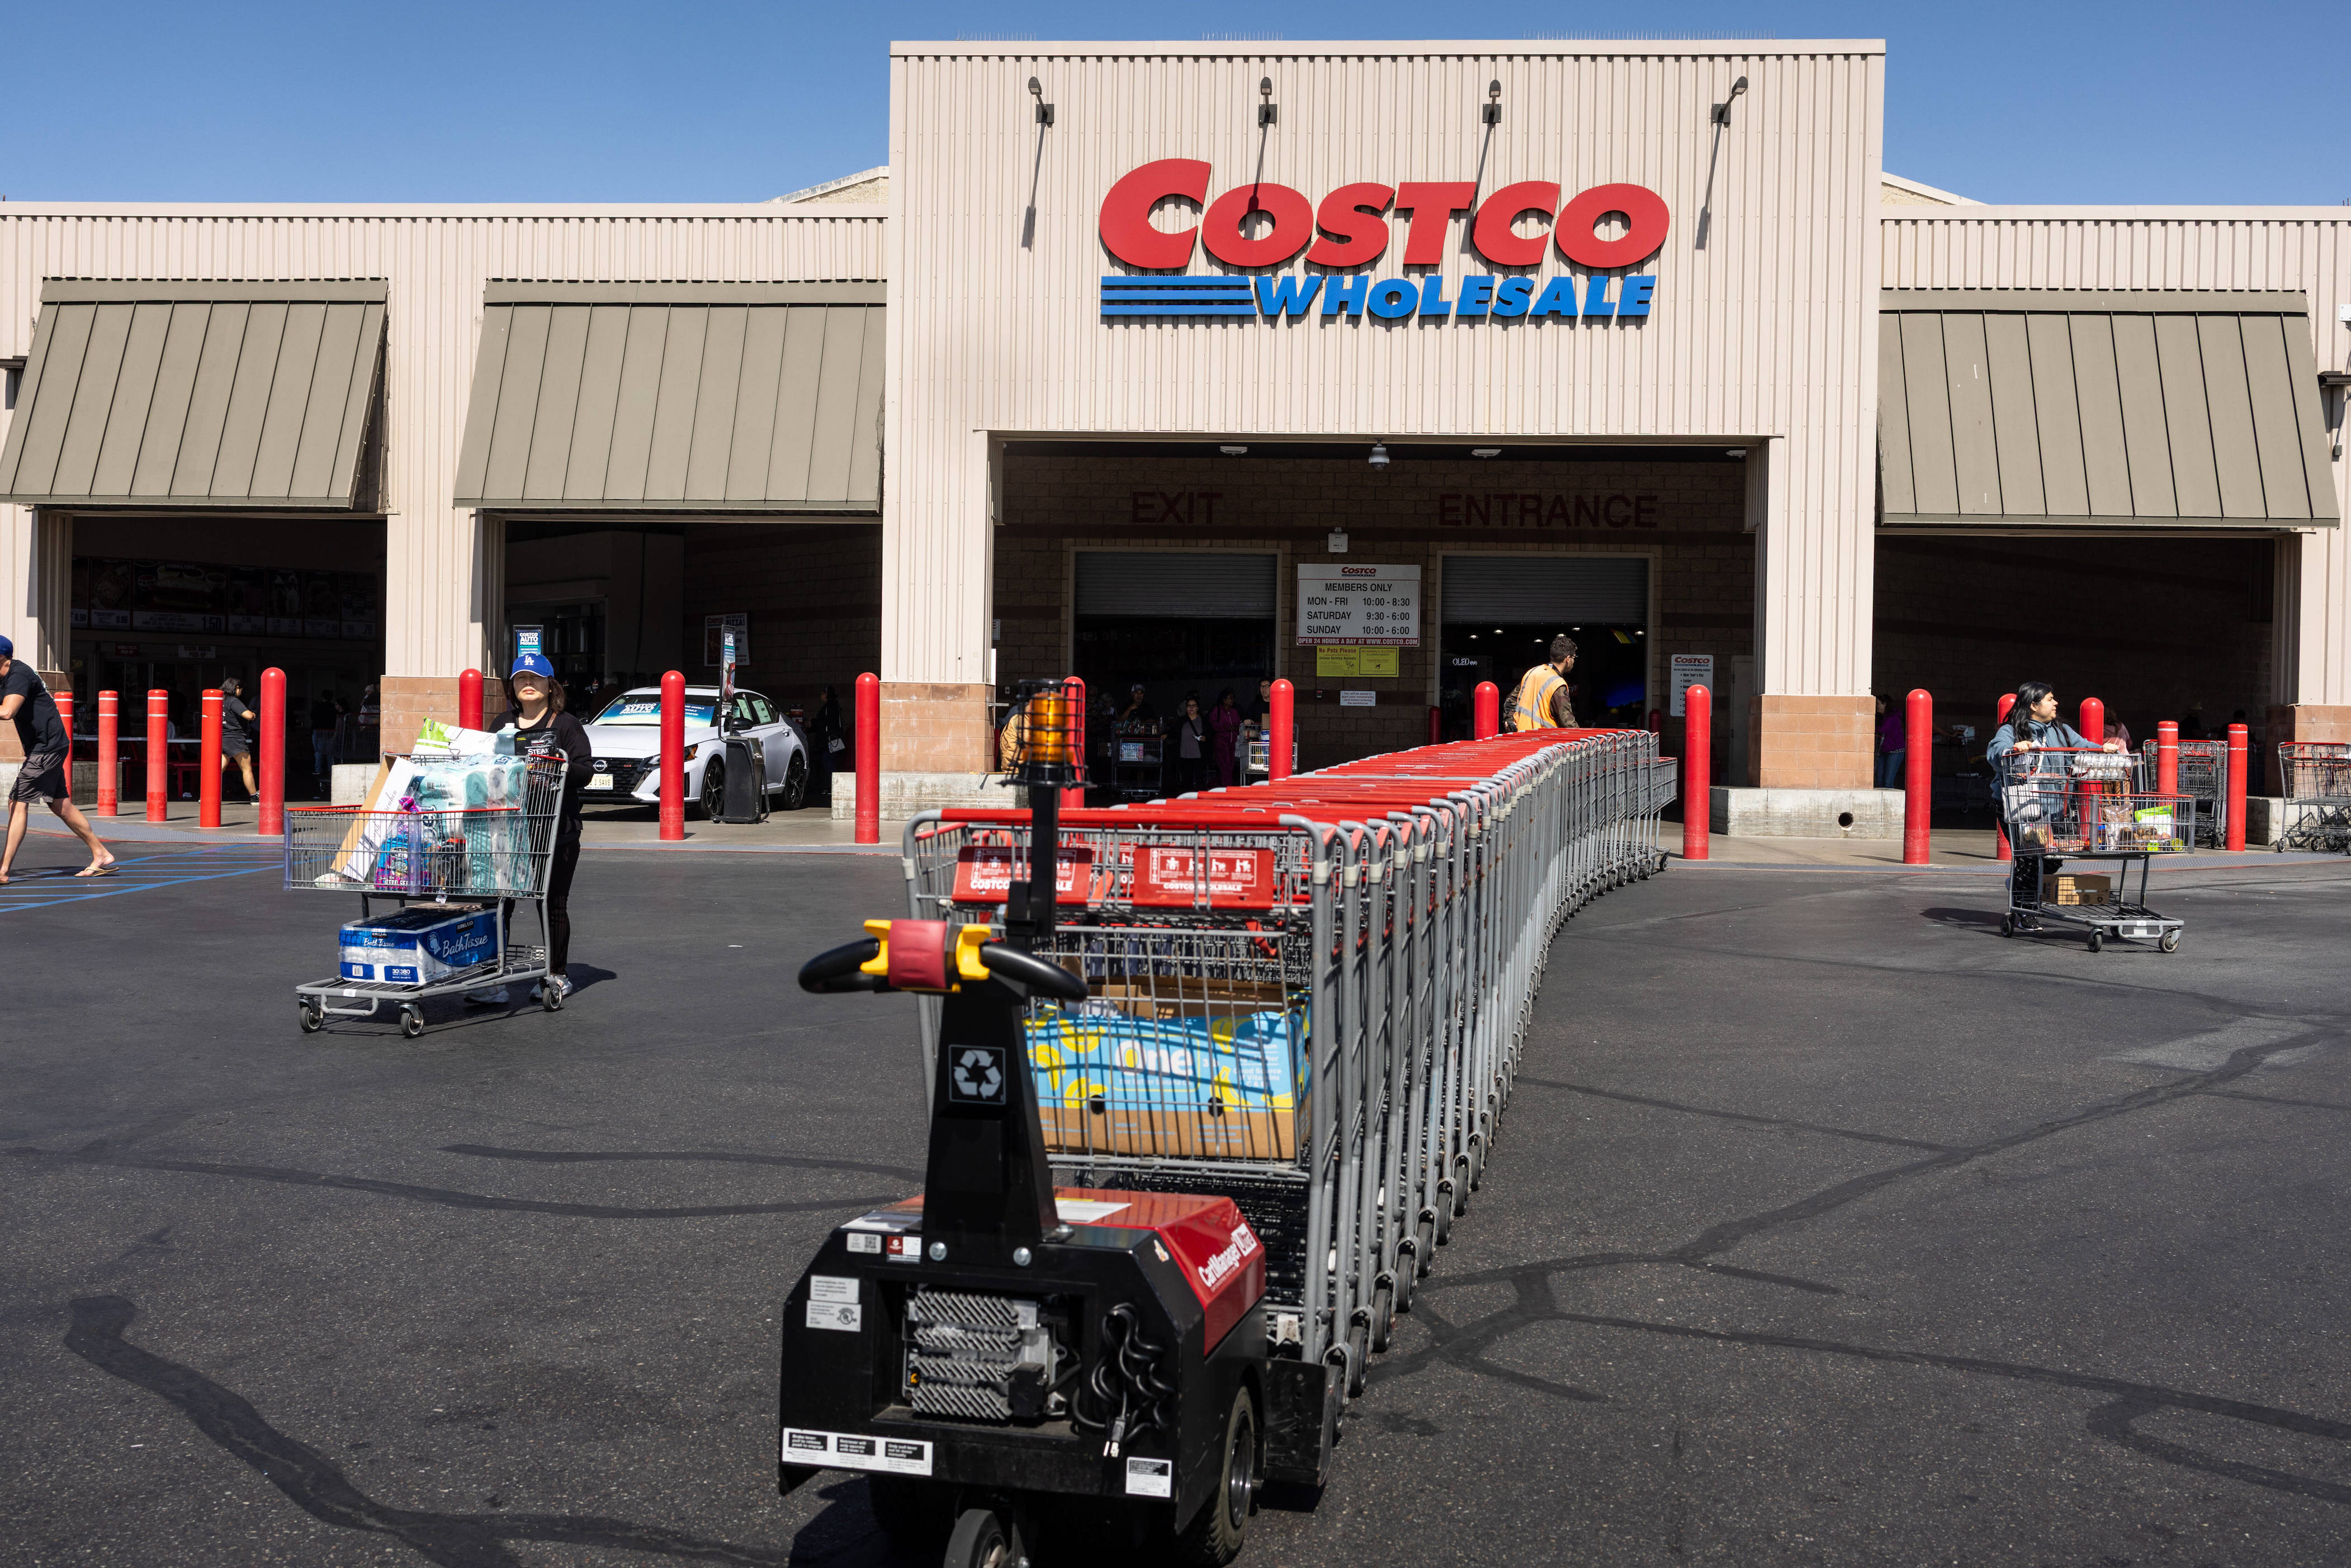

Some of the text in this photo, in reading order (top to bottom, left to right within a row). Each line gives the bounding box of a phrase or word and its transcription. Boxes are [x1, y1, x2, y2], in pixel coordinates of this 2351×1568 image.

[1099, 158, 1670, 269] COSTCO
[1255, 275, 1656, 319] WHOLESALE
[1132, 491, 1223, 524] EXIT
[1439, 494, 1658, 528] ENTRANCE
[1325, 583, 1368, 591] MEMBERS
[1307, 597, 1327, 605] MON
[1363, 598, 1385, 606] 10:00
[1392, 612, 1409, 620] 6:00
[202, 616, 221, 632] 1.50
[1307, 626, 1341, 634] SUNDAY
[524, 655, 534, 665] LA
[970, 880, 1010, 890] COSTCO
[456, 921, 474, 930] KIRKLAND
[364, 938, 378, 946] Bath
[442, 935, 465, 958] Bath
[464, 932, 488, 950] Tissue
[1115, 1040, 1194, 1077] One
[1198, 1243, 1242, 1288] CartManager
